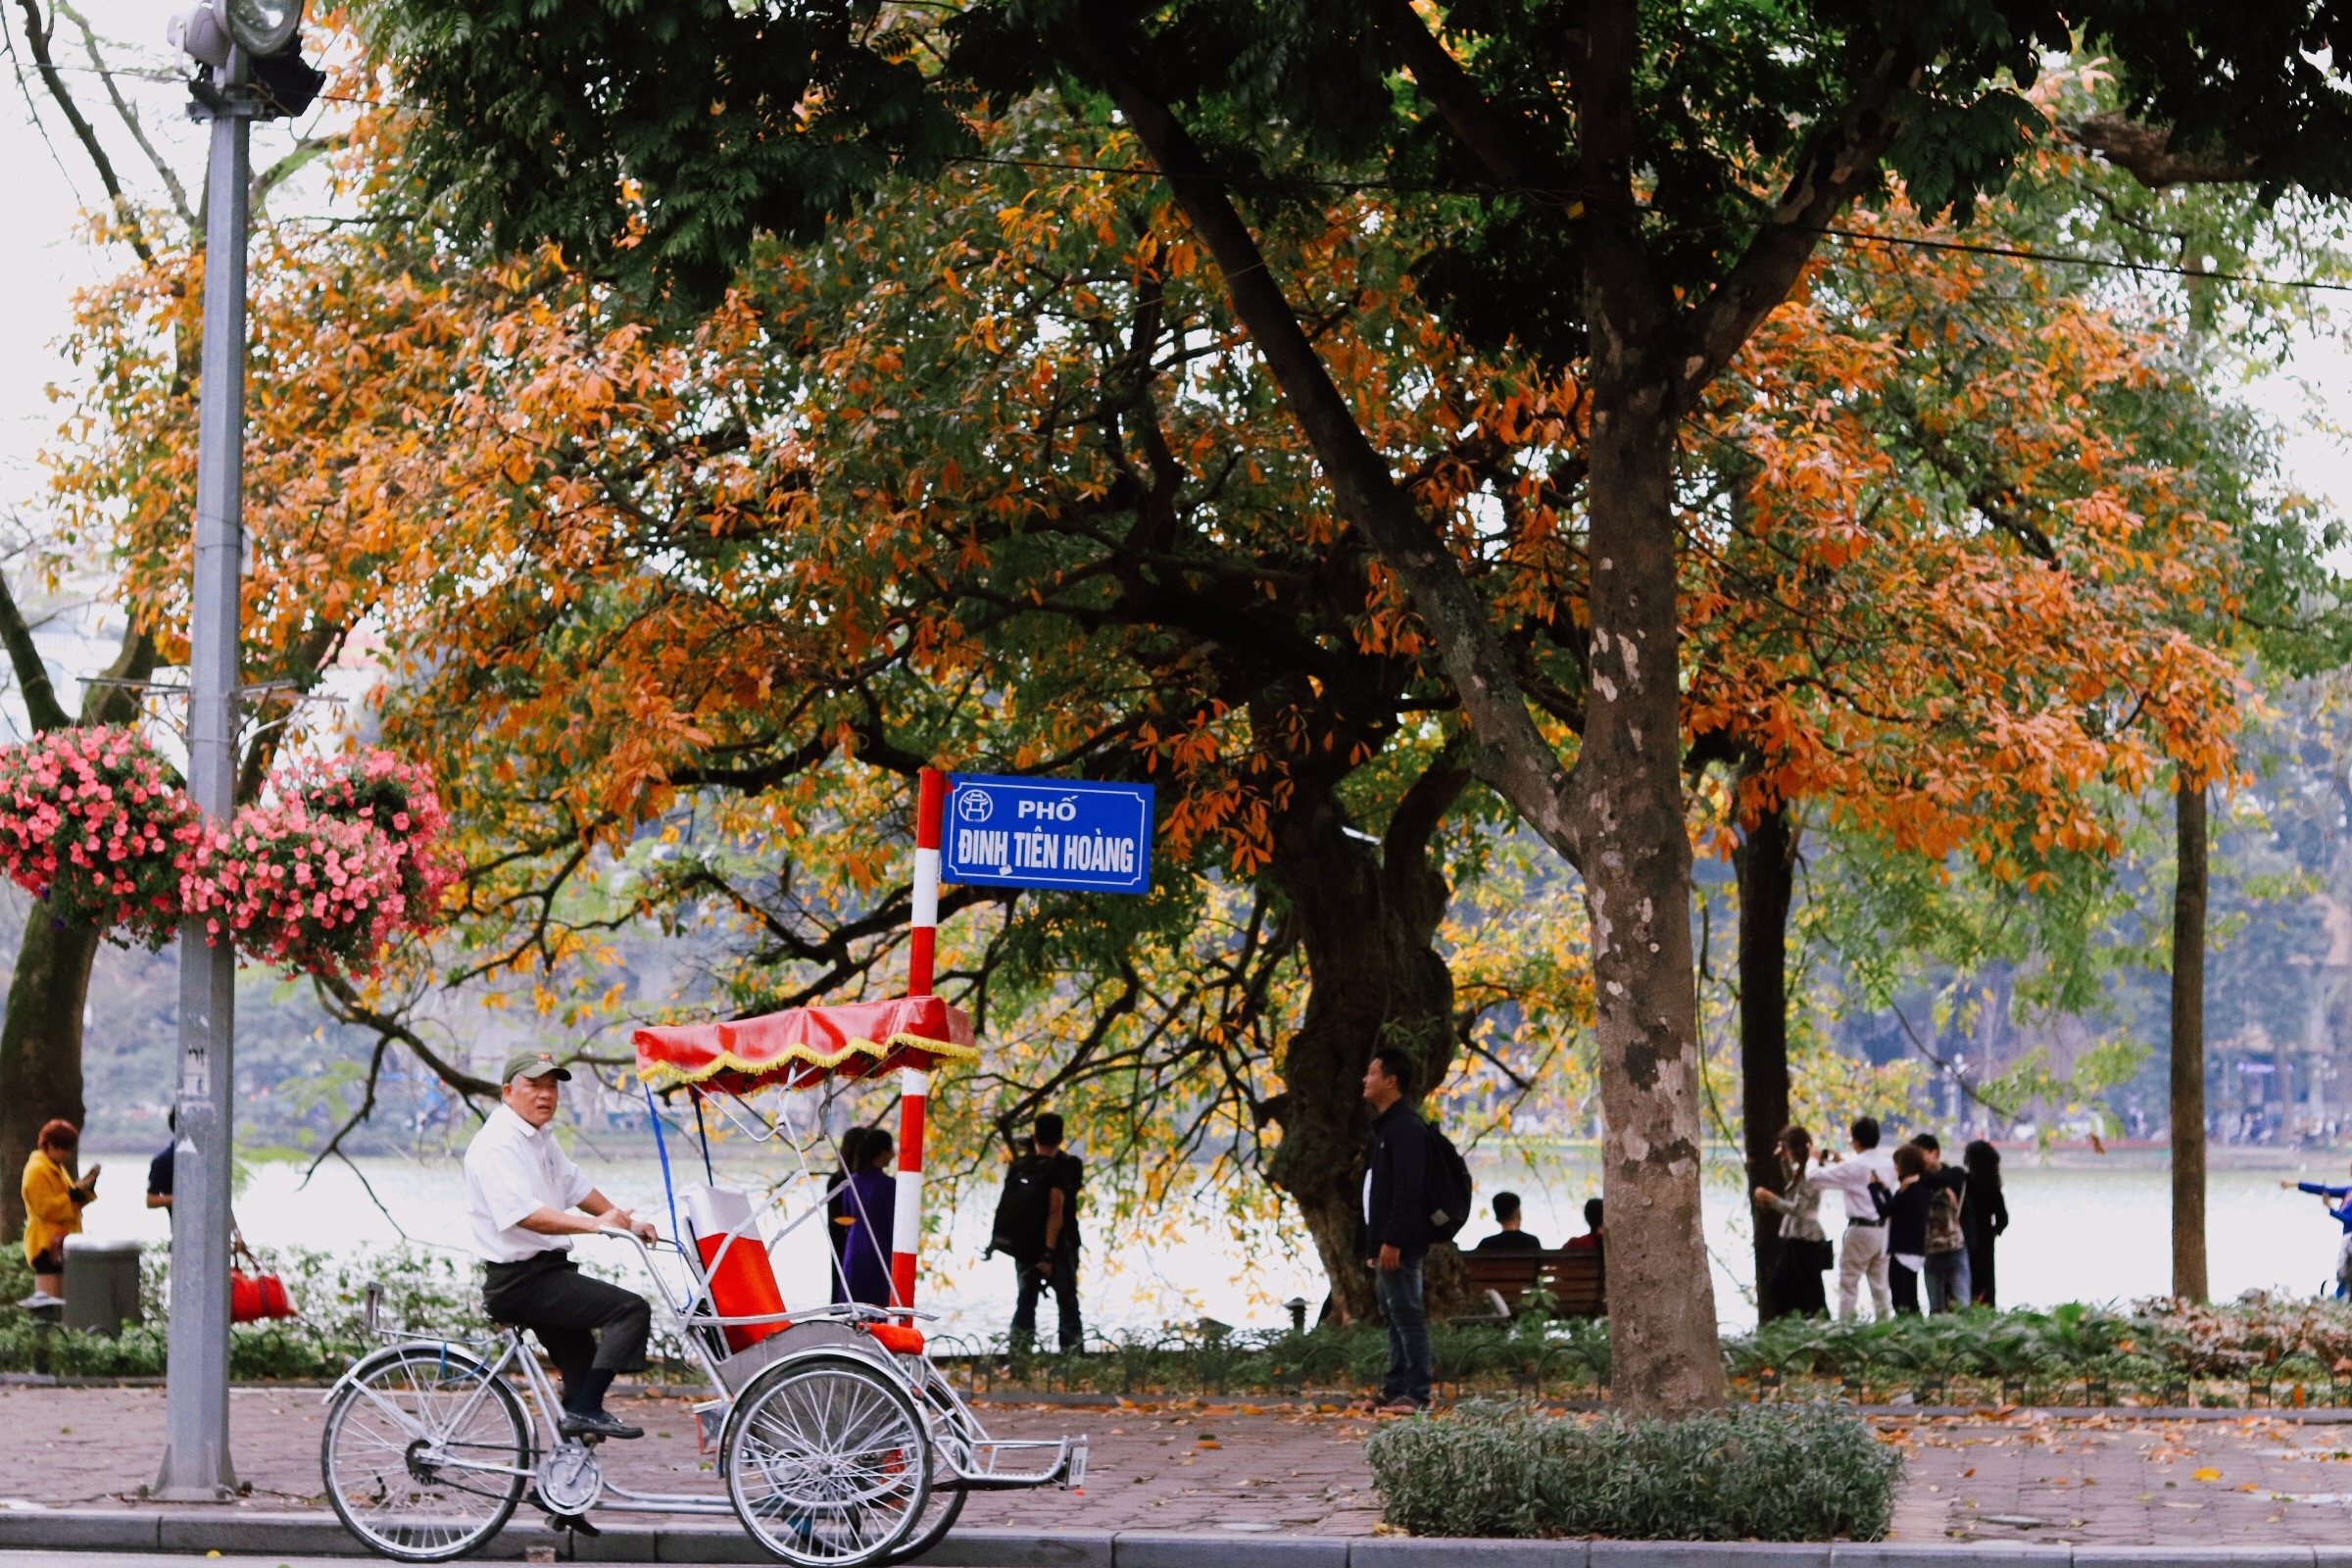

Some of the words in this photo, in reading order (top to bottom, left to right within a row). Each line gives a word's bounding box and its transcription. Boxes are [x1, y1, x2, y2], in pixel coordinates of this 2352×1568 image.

[1017, 795, 1079, 821] PHỐ
[957, 828, 1008, 866] ĐINH
[1013, 825, 1059, 869] TIÊN
[1063, 827, 1135, 873] HOÀNG
